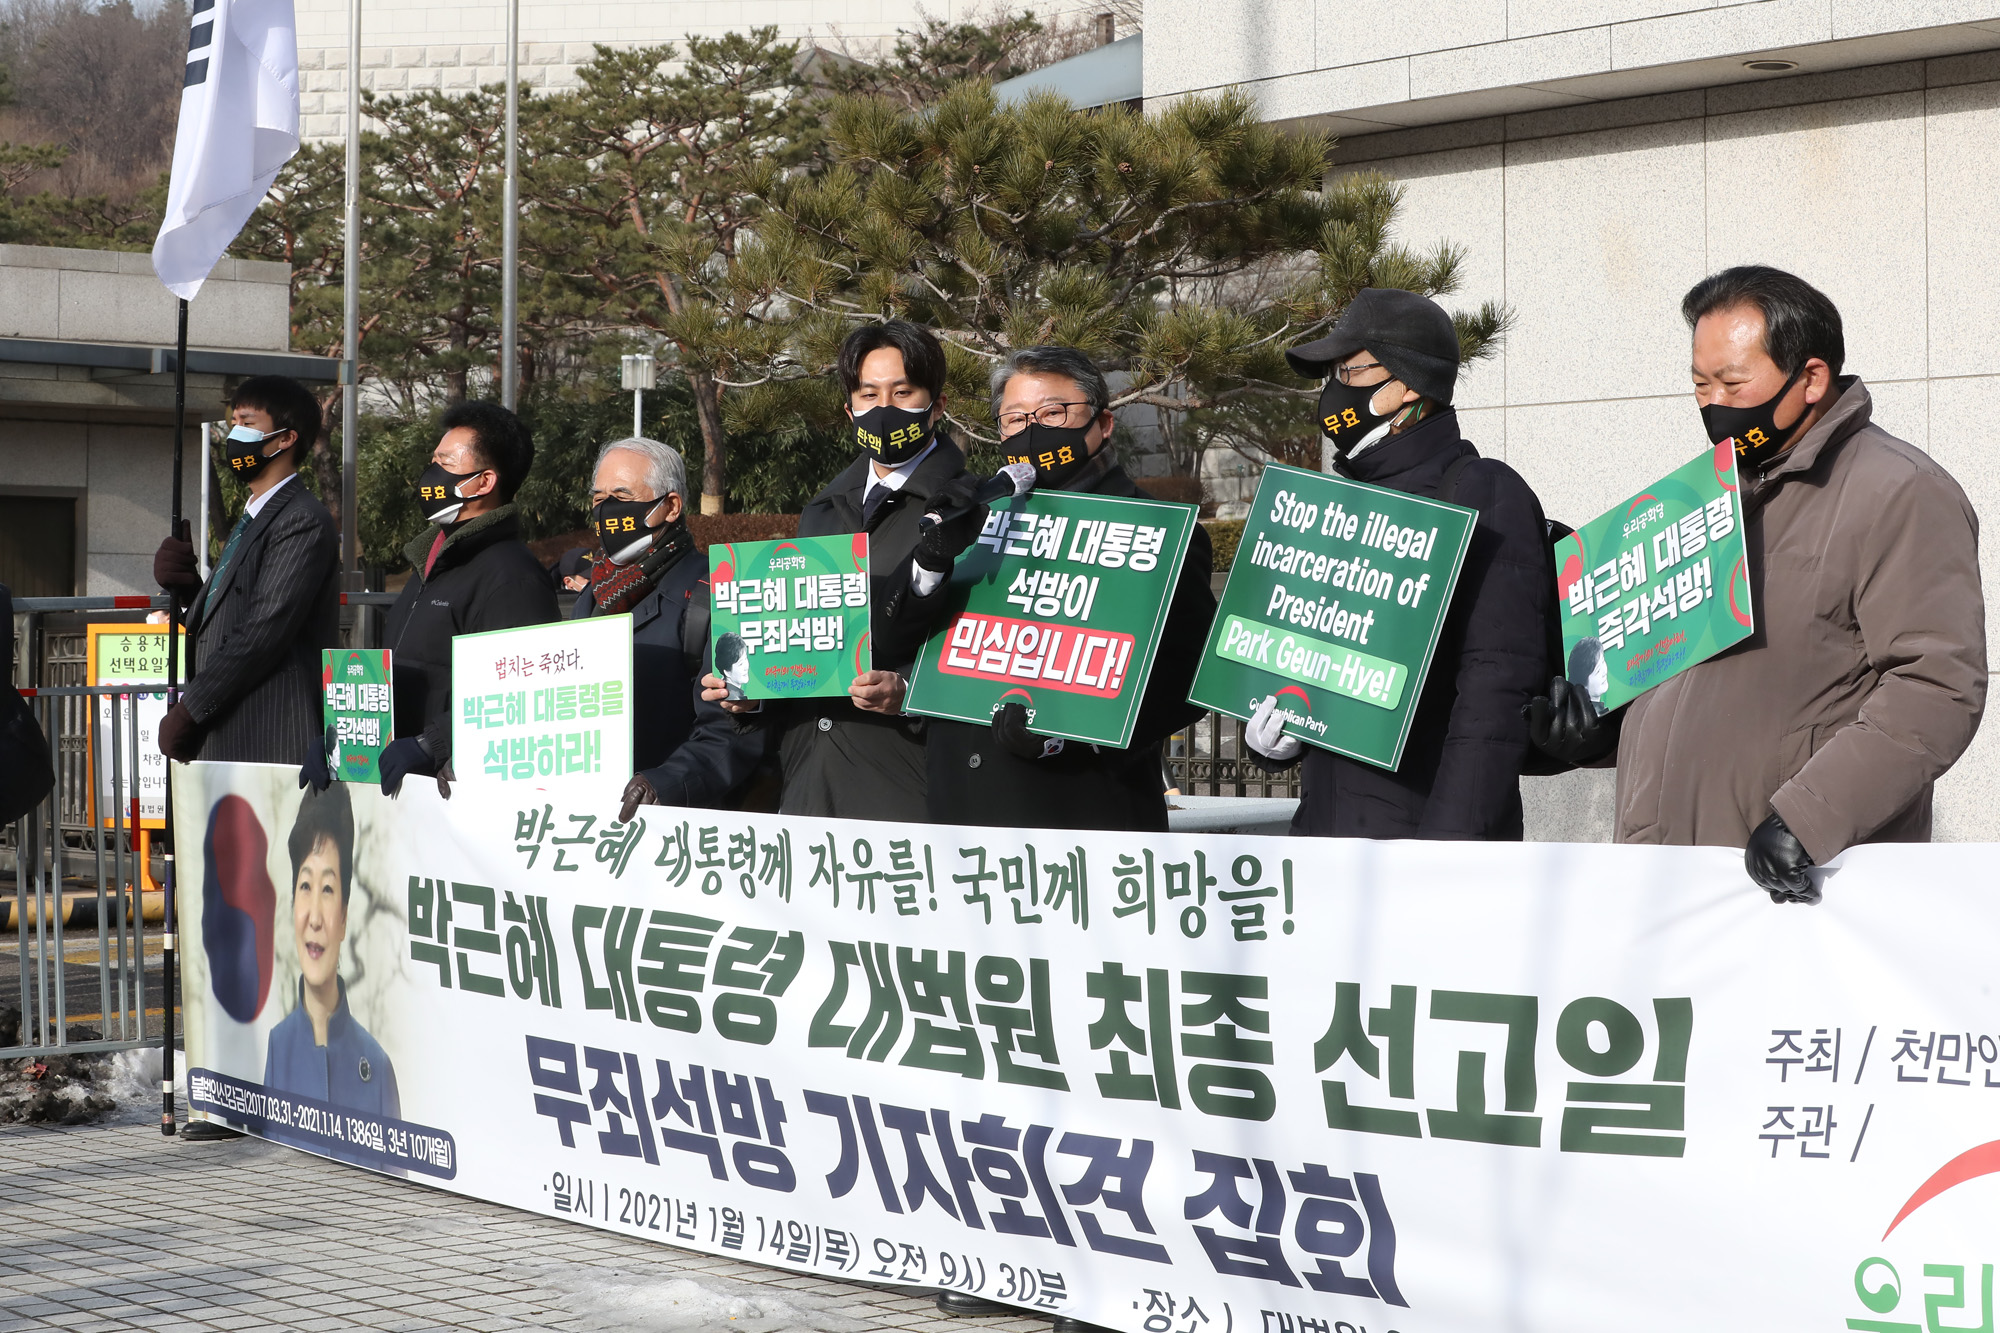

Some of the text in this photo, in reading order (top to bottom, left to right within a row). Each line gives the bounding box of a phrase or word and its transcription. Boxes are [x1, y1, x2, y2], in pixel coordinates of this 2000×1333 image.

[856, 422, 924, 454] 탄핵 무효
[1323, 407, 1360, 434] 무효
[1734, 426, 1769, 456] 무효
[231, 454, 257, 471] 무효
[1038, 445, 1075, 471] 무효
[420, 485, 446, 501] 무효
[605, 516, 636, 534] 무효
[977, 510, 1167, 572] 박근혜 대통령
[1270, 489, 1438, 561] Stop the illegal
[1622, 502, 1664, 539] 우리공화당
[768, 556, 806, 571] 우리공화당
[1250, 531, 1430, 608] incarceration of
[1567, 490, 1735, 616] 박근혜 대통령
[714, 571, 868, 615] 박근혜 대통령
[1006, 567, 1099, 621] 석방이
[1266, 584, 1374, 645] President
[1598, 556, 1713, 650] 즉각석방!
[740, 615, 844, 655] 무죄석방!
[946, 617, 1132, 690] 민심입니다!
[495, 648, 584, 680] 법치는 죽었다.
[1223, 620, 1397, 703] Park Geun-Hye!
[326, 683, 390, 712] 박근혜 대통령
[463, 680, 623, 730] 박근혜 대통령을
[336, 716, 380, 747] 즉각석방!
[1305, 715, 1328, 737] Party
[483, 729, 601, 781] 석방하라!
[514, 803, 1296, 942] 박근혜 대통령께 자유를! 국민께 희망을!
[408, 875, 1693, 1158] 박근혜 대통령 대법원 최종 선고일
[1765, 1027, 1841, 1083] 주최
[388, 1128, 408, 1158] 3년
[1758, 1104, 1838, 1159] 주관
[525, 1034, 1411, 1309] 무죄석방 기자회견 집회
[619, 1187, 697, 1241] 2021년
[708, 1206, 745, 1251] 1월
[756, 1216, 860, 1272] 14일(목)
[868, 1237, 927, 1283] 오전
[938, 1251, 986, 1293] 9시
[997, 1262, 1067, 1310] 30분
